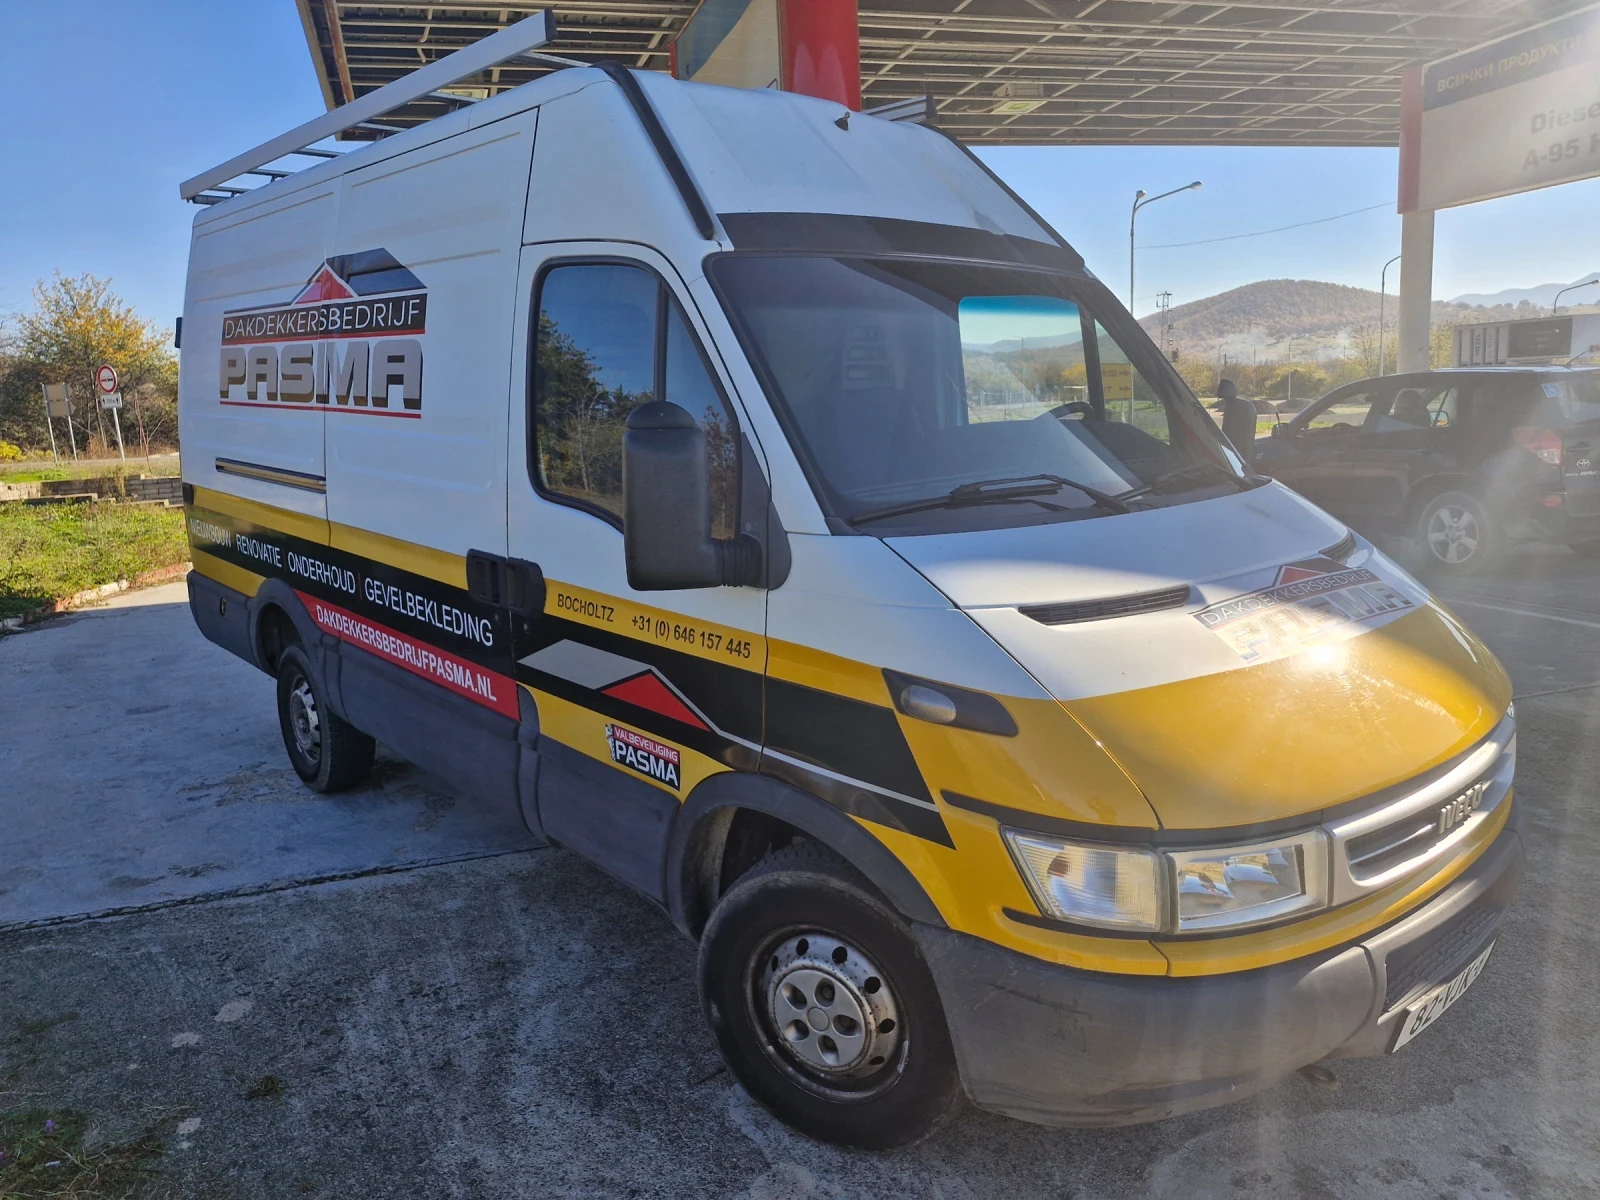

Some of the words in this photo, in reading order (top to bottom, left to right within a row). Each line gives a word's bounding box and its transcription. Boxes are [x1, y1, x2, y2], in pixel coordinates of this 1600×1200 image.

[1436, 63, 1494, 93] ВСИЧКИ
[224, 299, 421, 339] DAKDEKKERSBEDRIJF
[220, 339, 424, 410] PASMA
[236, 533, 283, 568] RENOVATIE
[288, 551, 356, 594] ONDERHOUD
[365, 577, 493, 646] GEVELBEKLEDING
[1200, 569, 1373, 626] DAKDEKKERSBEDRIJF
[316, 604, 498, 702] DAKDEKKERSBEDRIJFPASMA.NL
[557, 593, 615, 623] BOCHOLTZ
[632, 615, 651, 633] +31
[655, 619, 670, 641] (0)
[673, 625, 695, 644] 646
[700, 632, 722, 651] 157
[725, 638, 751, 659] 445
[614, 727, 679, 763] VALBEVEILIGING
[615, 741, 679, 787] PASMA
[1437, 783, 1483, 835] IVECO
